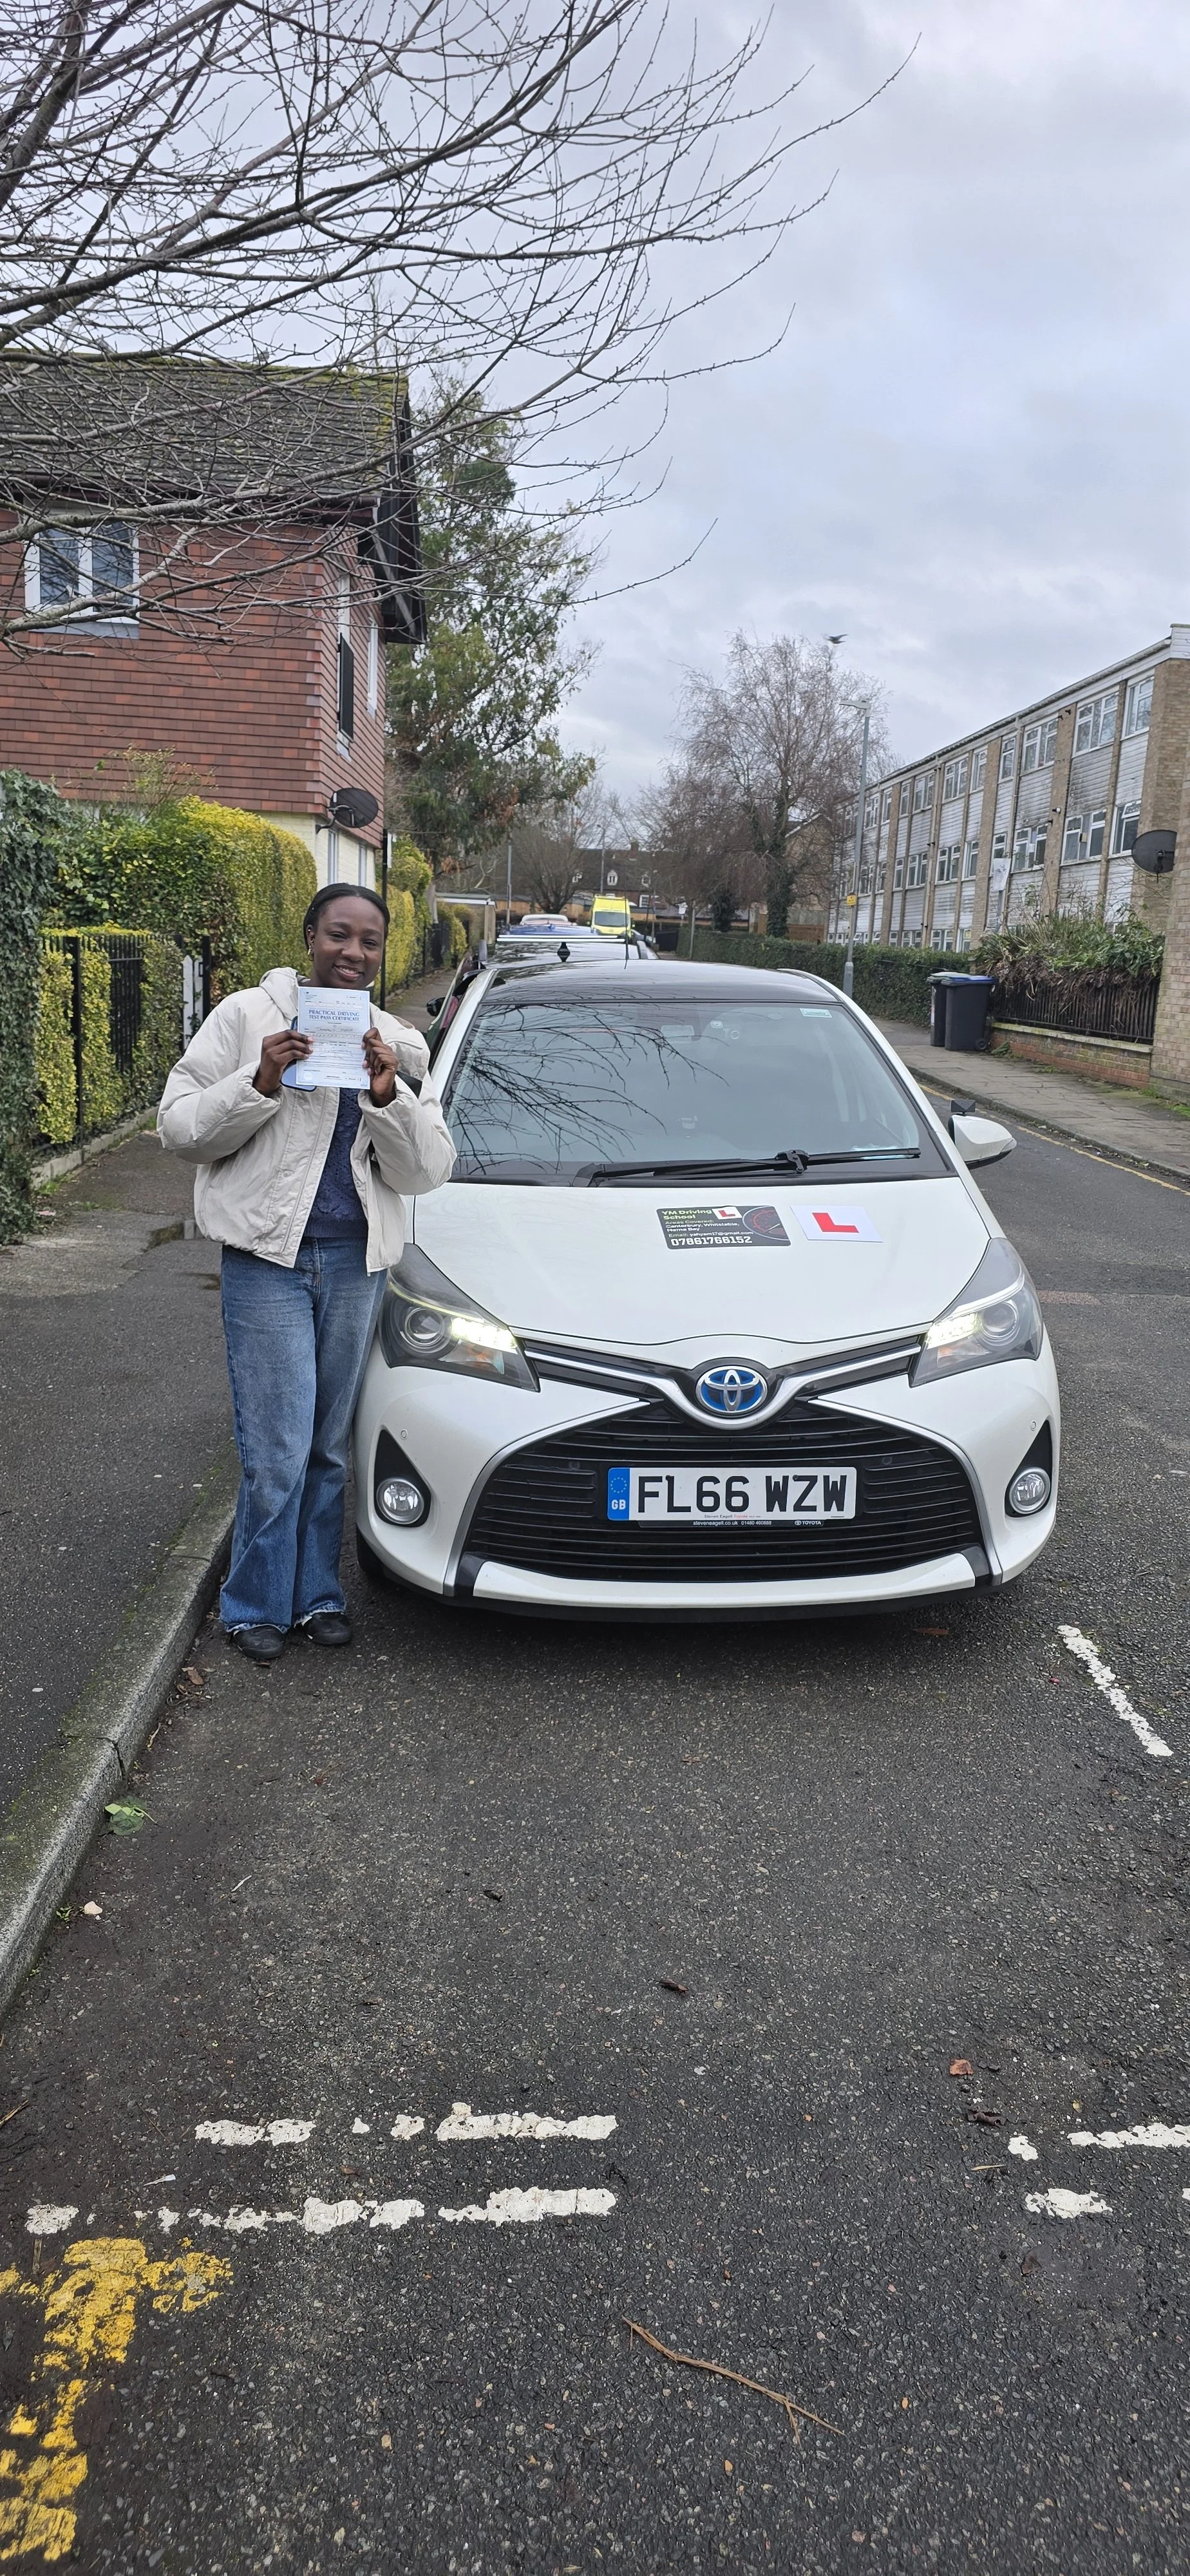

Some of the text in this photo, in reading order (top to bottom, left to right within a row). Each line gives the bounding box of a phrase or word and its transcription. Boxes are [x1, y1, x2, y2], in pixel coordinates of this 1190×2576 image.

[811, 1212, 859, 1233] L
[670, 1236, 753, 1246] 07861766152
[638, 1475, 847, 1513] FL66 WZW
[611, 1499, 626, 1510] GB
